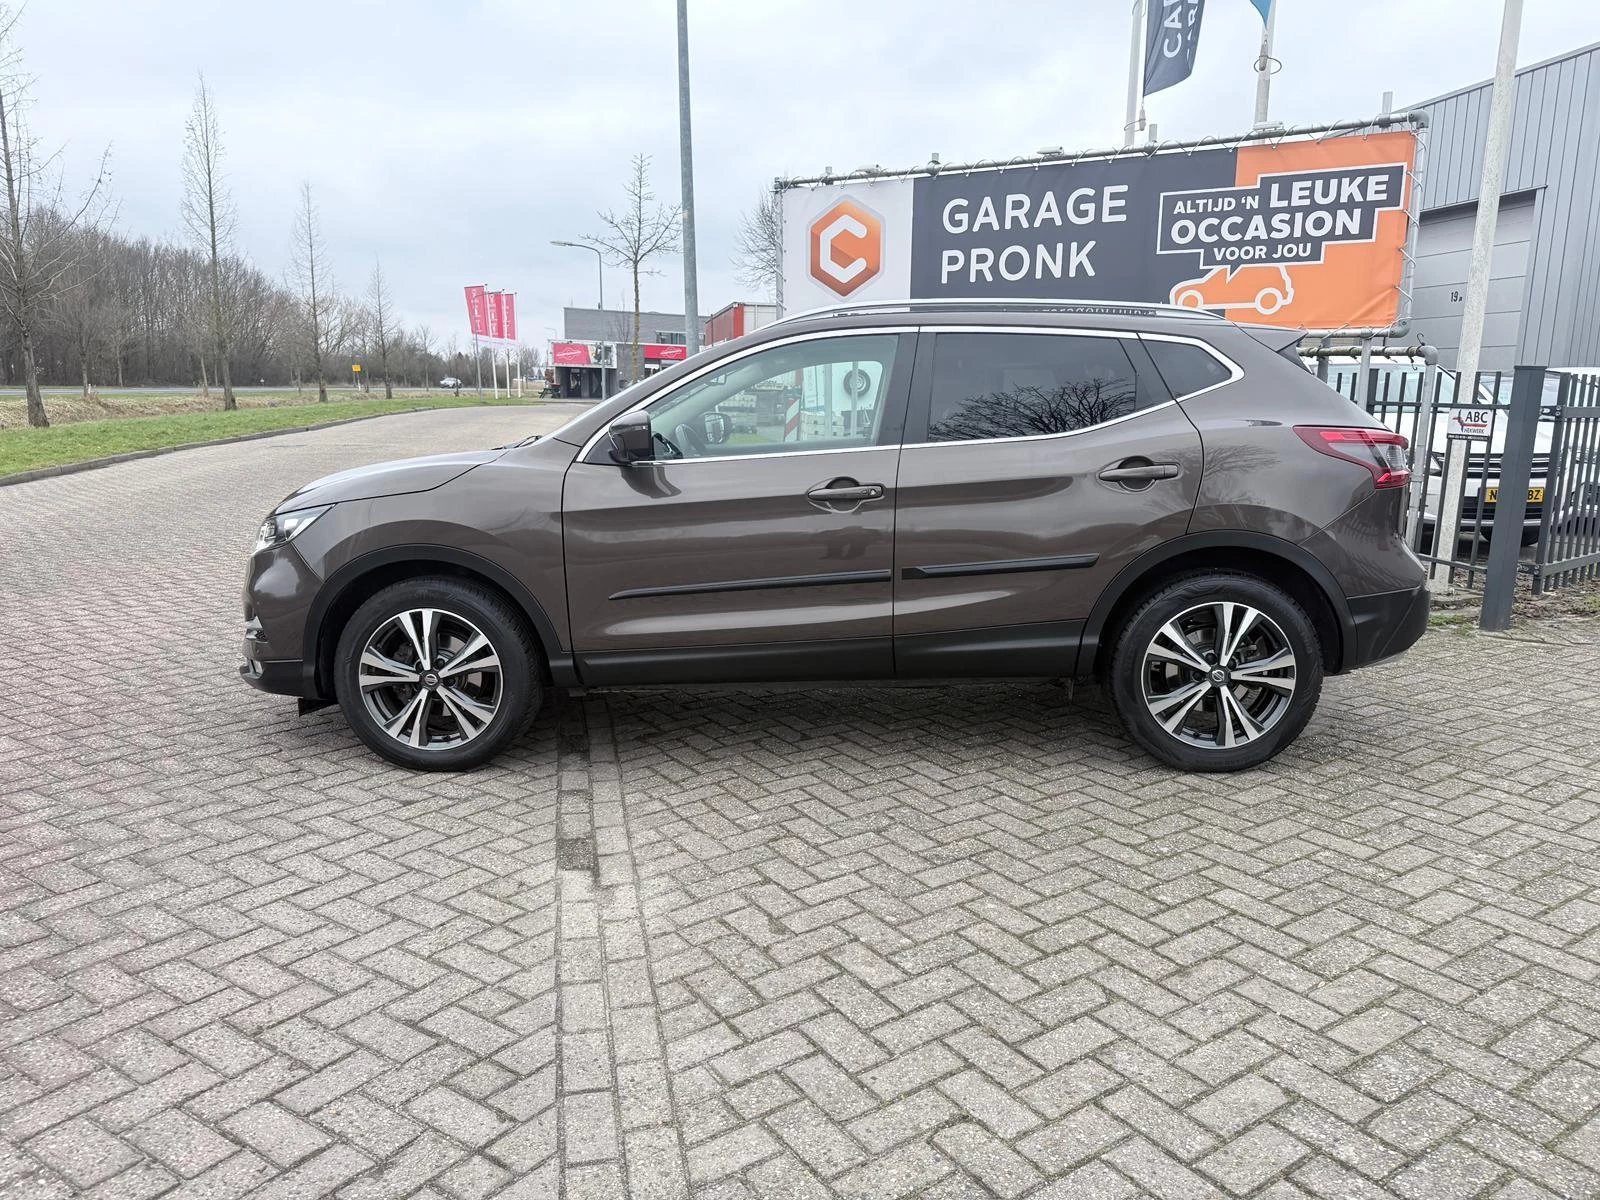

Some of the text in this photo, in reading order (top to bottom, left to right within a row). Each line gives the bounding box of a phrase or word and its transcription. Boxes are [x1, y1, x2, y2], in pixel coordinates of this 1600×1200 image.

[942, 184, 1129, 234] GARAGE
[1173, 197, 1236, 214] ALTIJD
[1269, 174, 1389, 208] LEUKE
[1170, 208, 1361, 244] OCCASION
[941, 240, 1096, 284] PRONK
[1213, 243, 1311, 261] VOOR JOU
[1465, 411, 1488, 423] ABC
